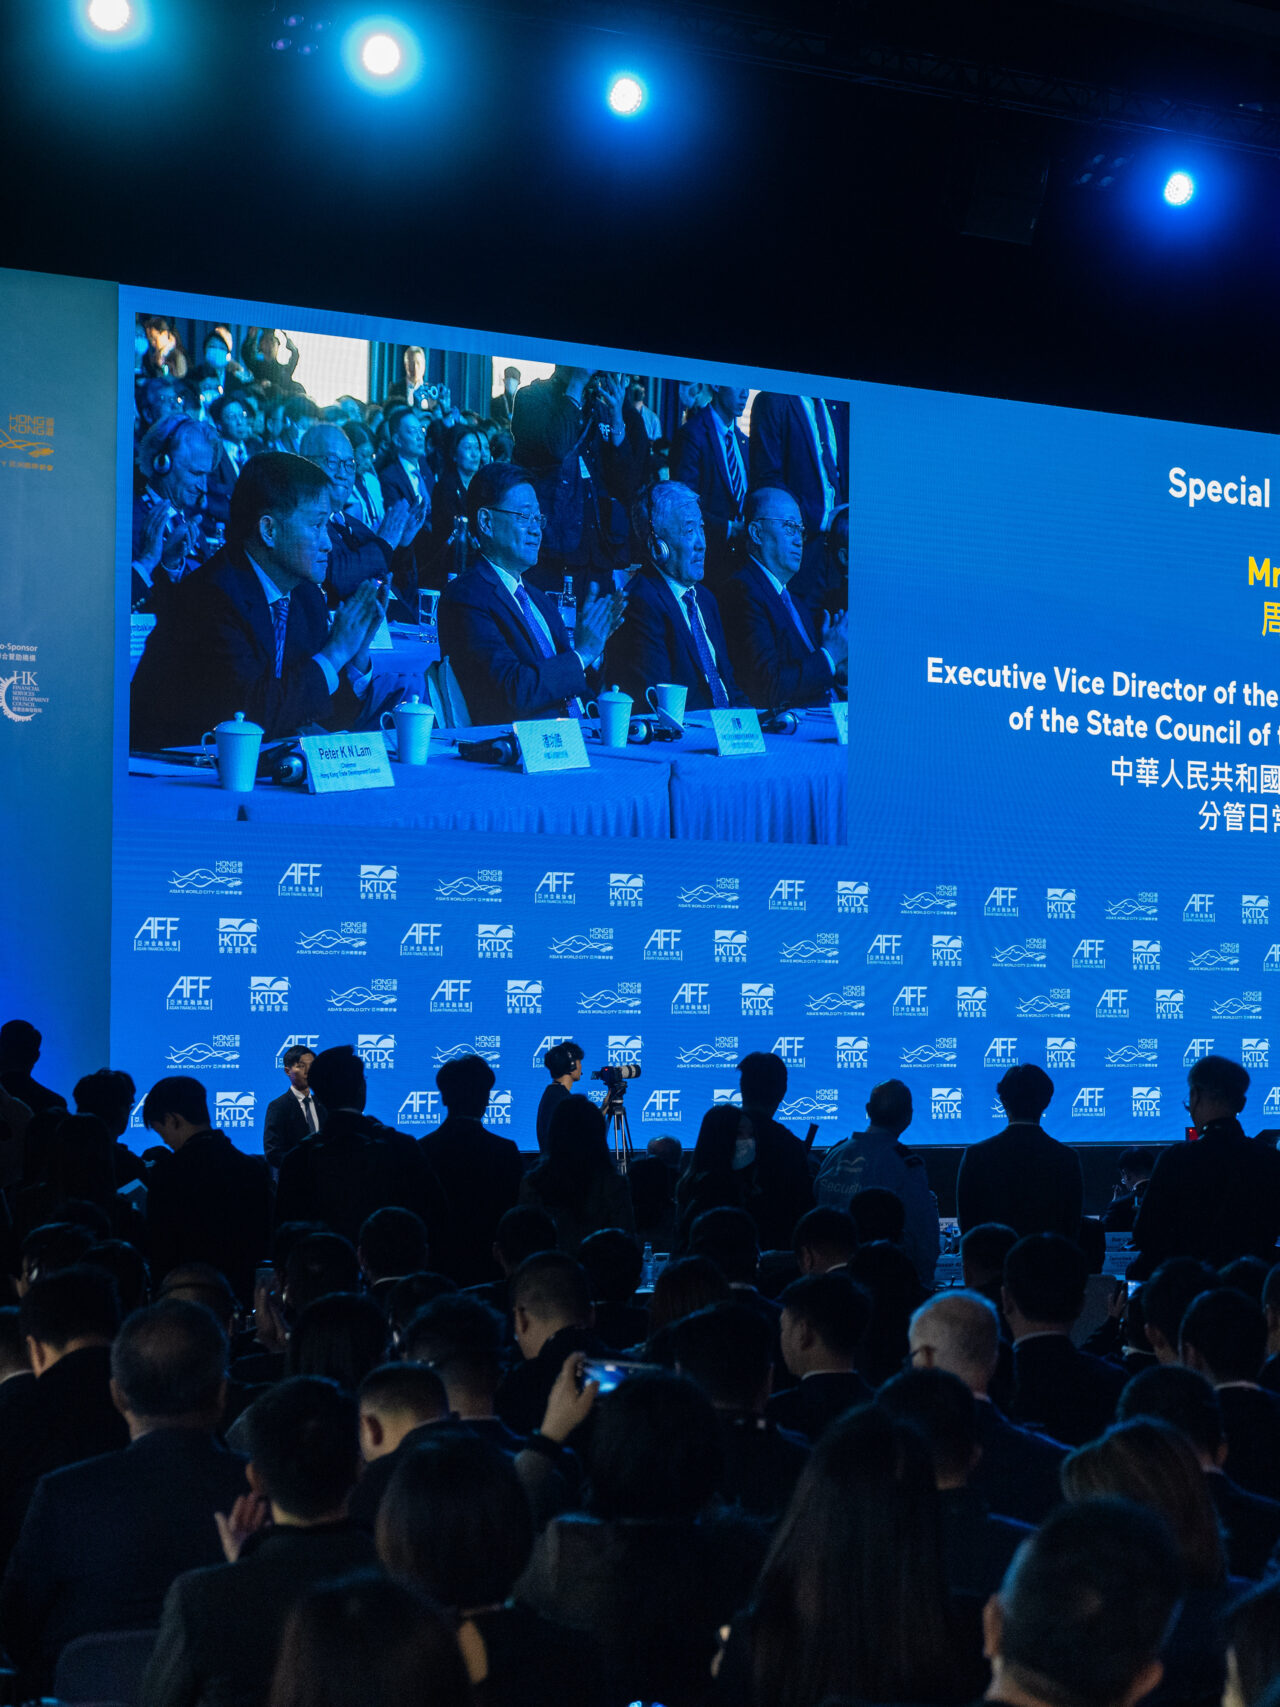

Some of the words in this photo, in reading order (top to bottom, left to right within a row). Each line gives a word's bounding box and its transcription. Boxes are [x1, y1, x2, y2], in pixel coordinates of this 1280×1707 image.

[9, 414, 45, 425] HONG
[9, 424, 45, 435] KONG
[1168, 467, 1269, 507] Special
[0, 643, 38, 652] o-Sponsor
[13, 671, 38, 686] HK
[928, 657, 1046, 690] Executive
[1054, 667, 1104, 695] Vice
[1113, 672, 1206, 702] Director
[1214, 681, 1236, 704] of
[1243, 682, 1278, 707] the
[1009, 706, 1033, 730] of
[1041, 708, 1078, 733] the
[1087, 710, 1147, 738] State
[1156, 715, 1240, 744] Council
[1249, 723, 1270, 746] of
[318, 748, 339, 760] Peter
[340, 746, 347, 758] K
[347, 746, 354, 758] N
[355, 745, 372, 757] Lam
[279, 863, 322, 885] AFF
[360, 880, 397, 893] HKTDC
[536, 872, 575, 892] AFF
[610, 888, 643, 900] HKTDC
[770, 880, 806, 900] AFF
[985, 887, 1018, 906] AFF
[837, 895, 868, 907] HKTDC
[1047, 901, 1076, 913] HKTDC
[1184, 894, 1215, 912] AFF
[1242, 908, 1268, 918] HKTDC
[135, 917, 180, 939] AFF
[401, 923, 443, 945] AFF
[219, 933, 257, 946] HKTDC
[478, 939, 513, 951] HKTDC
[645, 929, 683, 949] AFF
[868, 934, 902, 954] AFF
[714, 944, 747, 956] HKTDC
[932, 949, 962, 960] HKTDC
[1073, 939, 1105, 958] AFF
[1133, 953, 1160, 964] HKTDC
[167, 976, 212, 998] AFF
[431, 979, 472, 1000] AFF
[250, 992, 288, 1005] HKTDC
[507, 994, 542, 1007] HKTDC
[985, 1038, 1018, 1057] AFF
